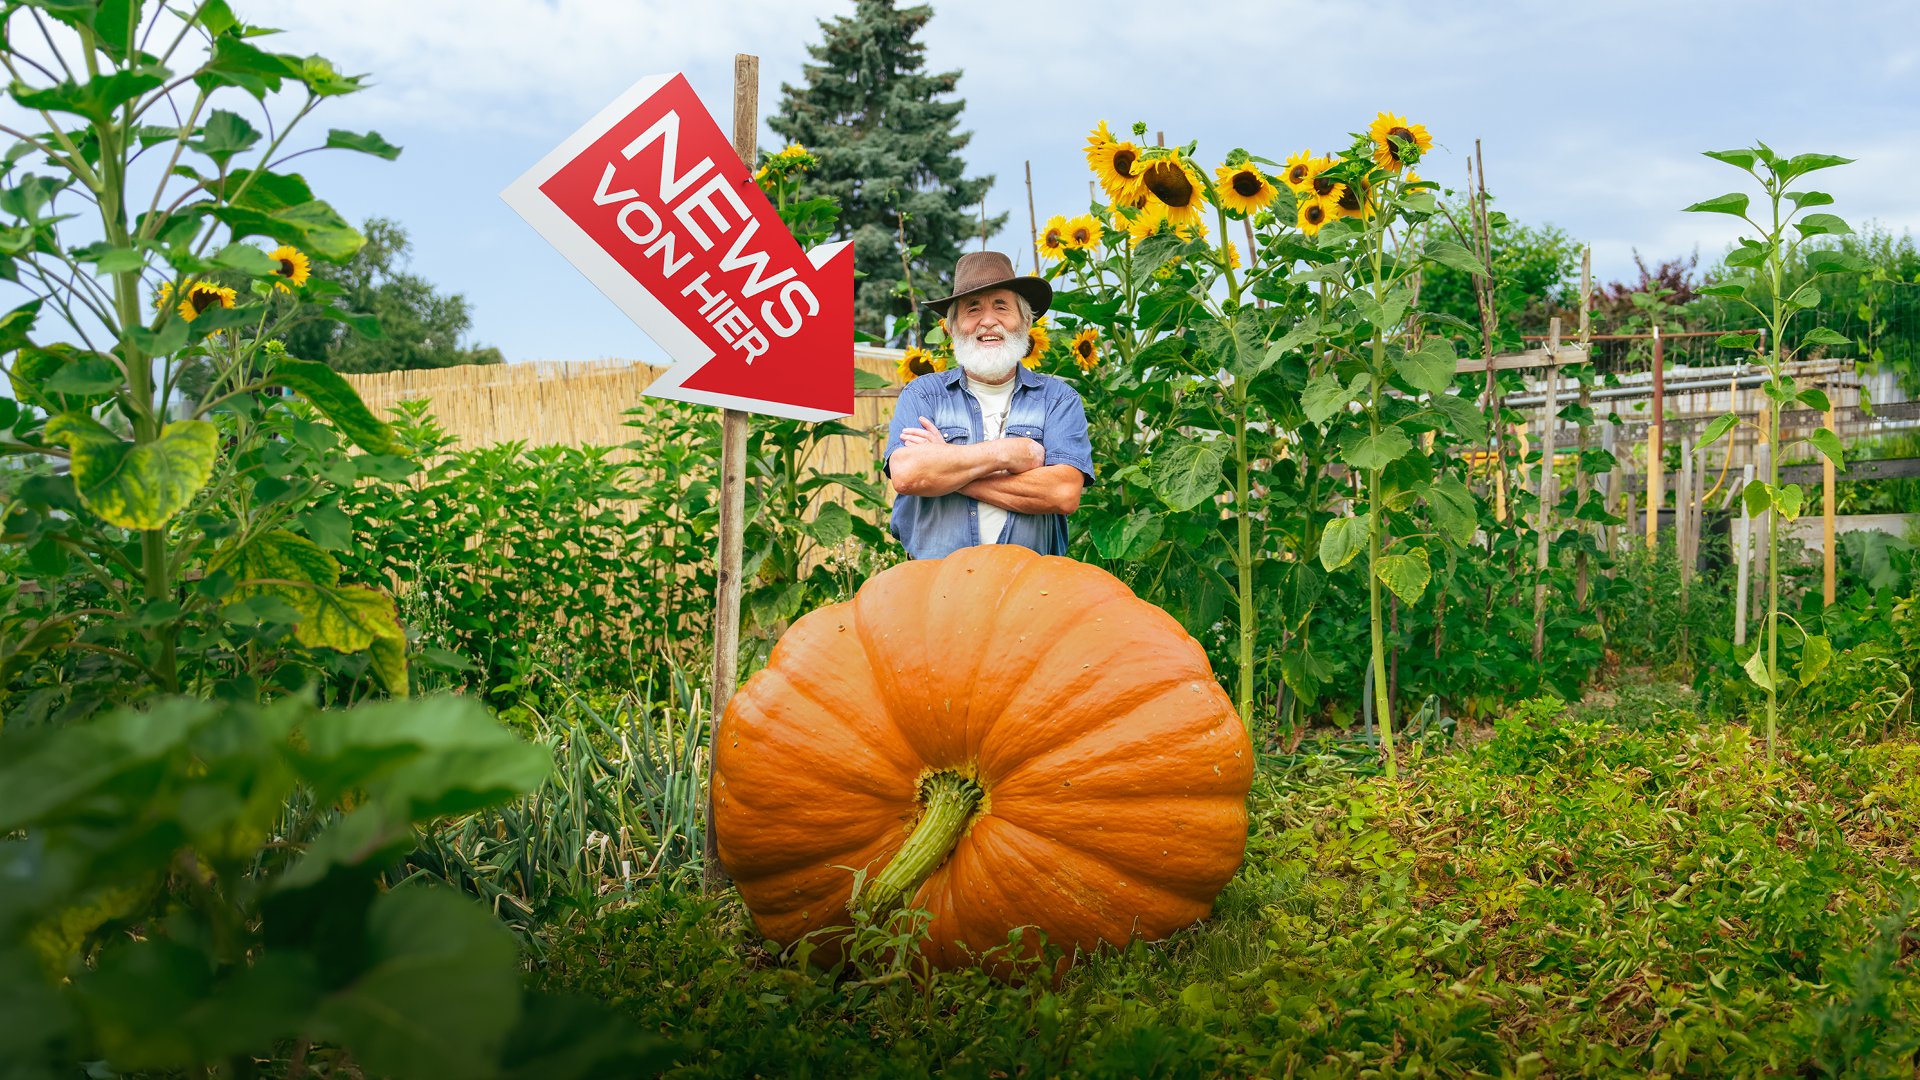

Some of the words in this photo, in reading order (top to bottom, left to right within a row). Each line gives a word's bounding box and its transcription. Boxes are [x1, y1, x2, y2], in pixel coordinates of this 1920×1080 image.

[592, 161, 695, 279] VON
[680, 271, 770, 366] HIER
[620, 108, 820, 338] NEWS
